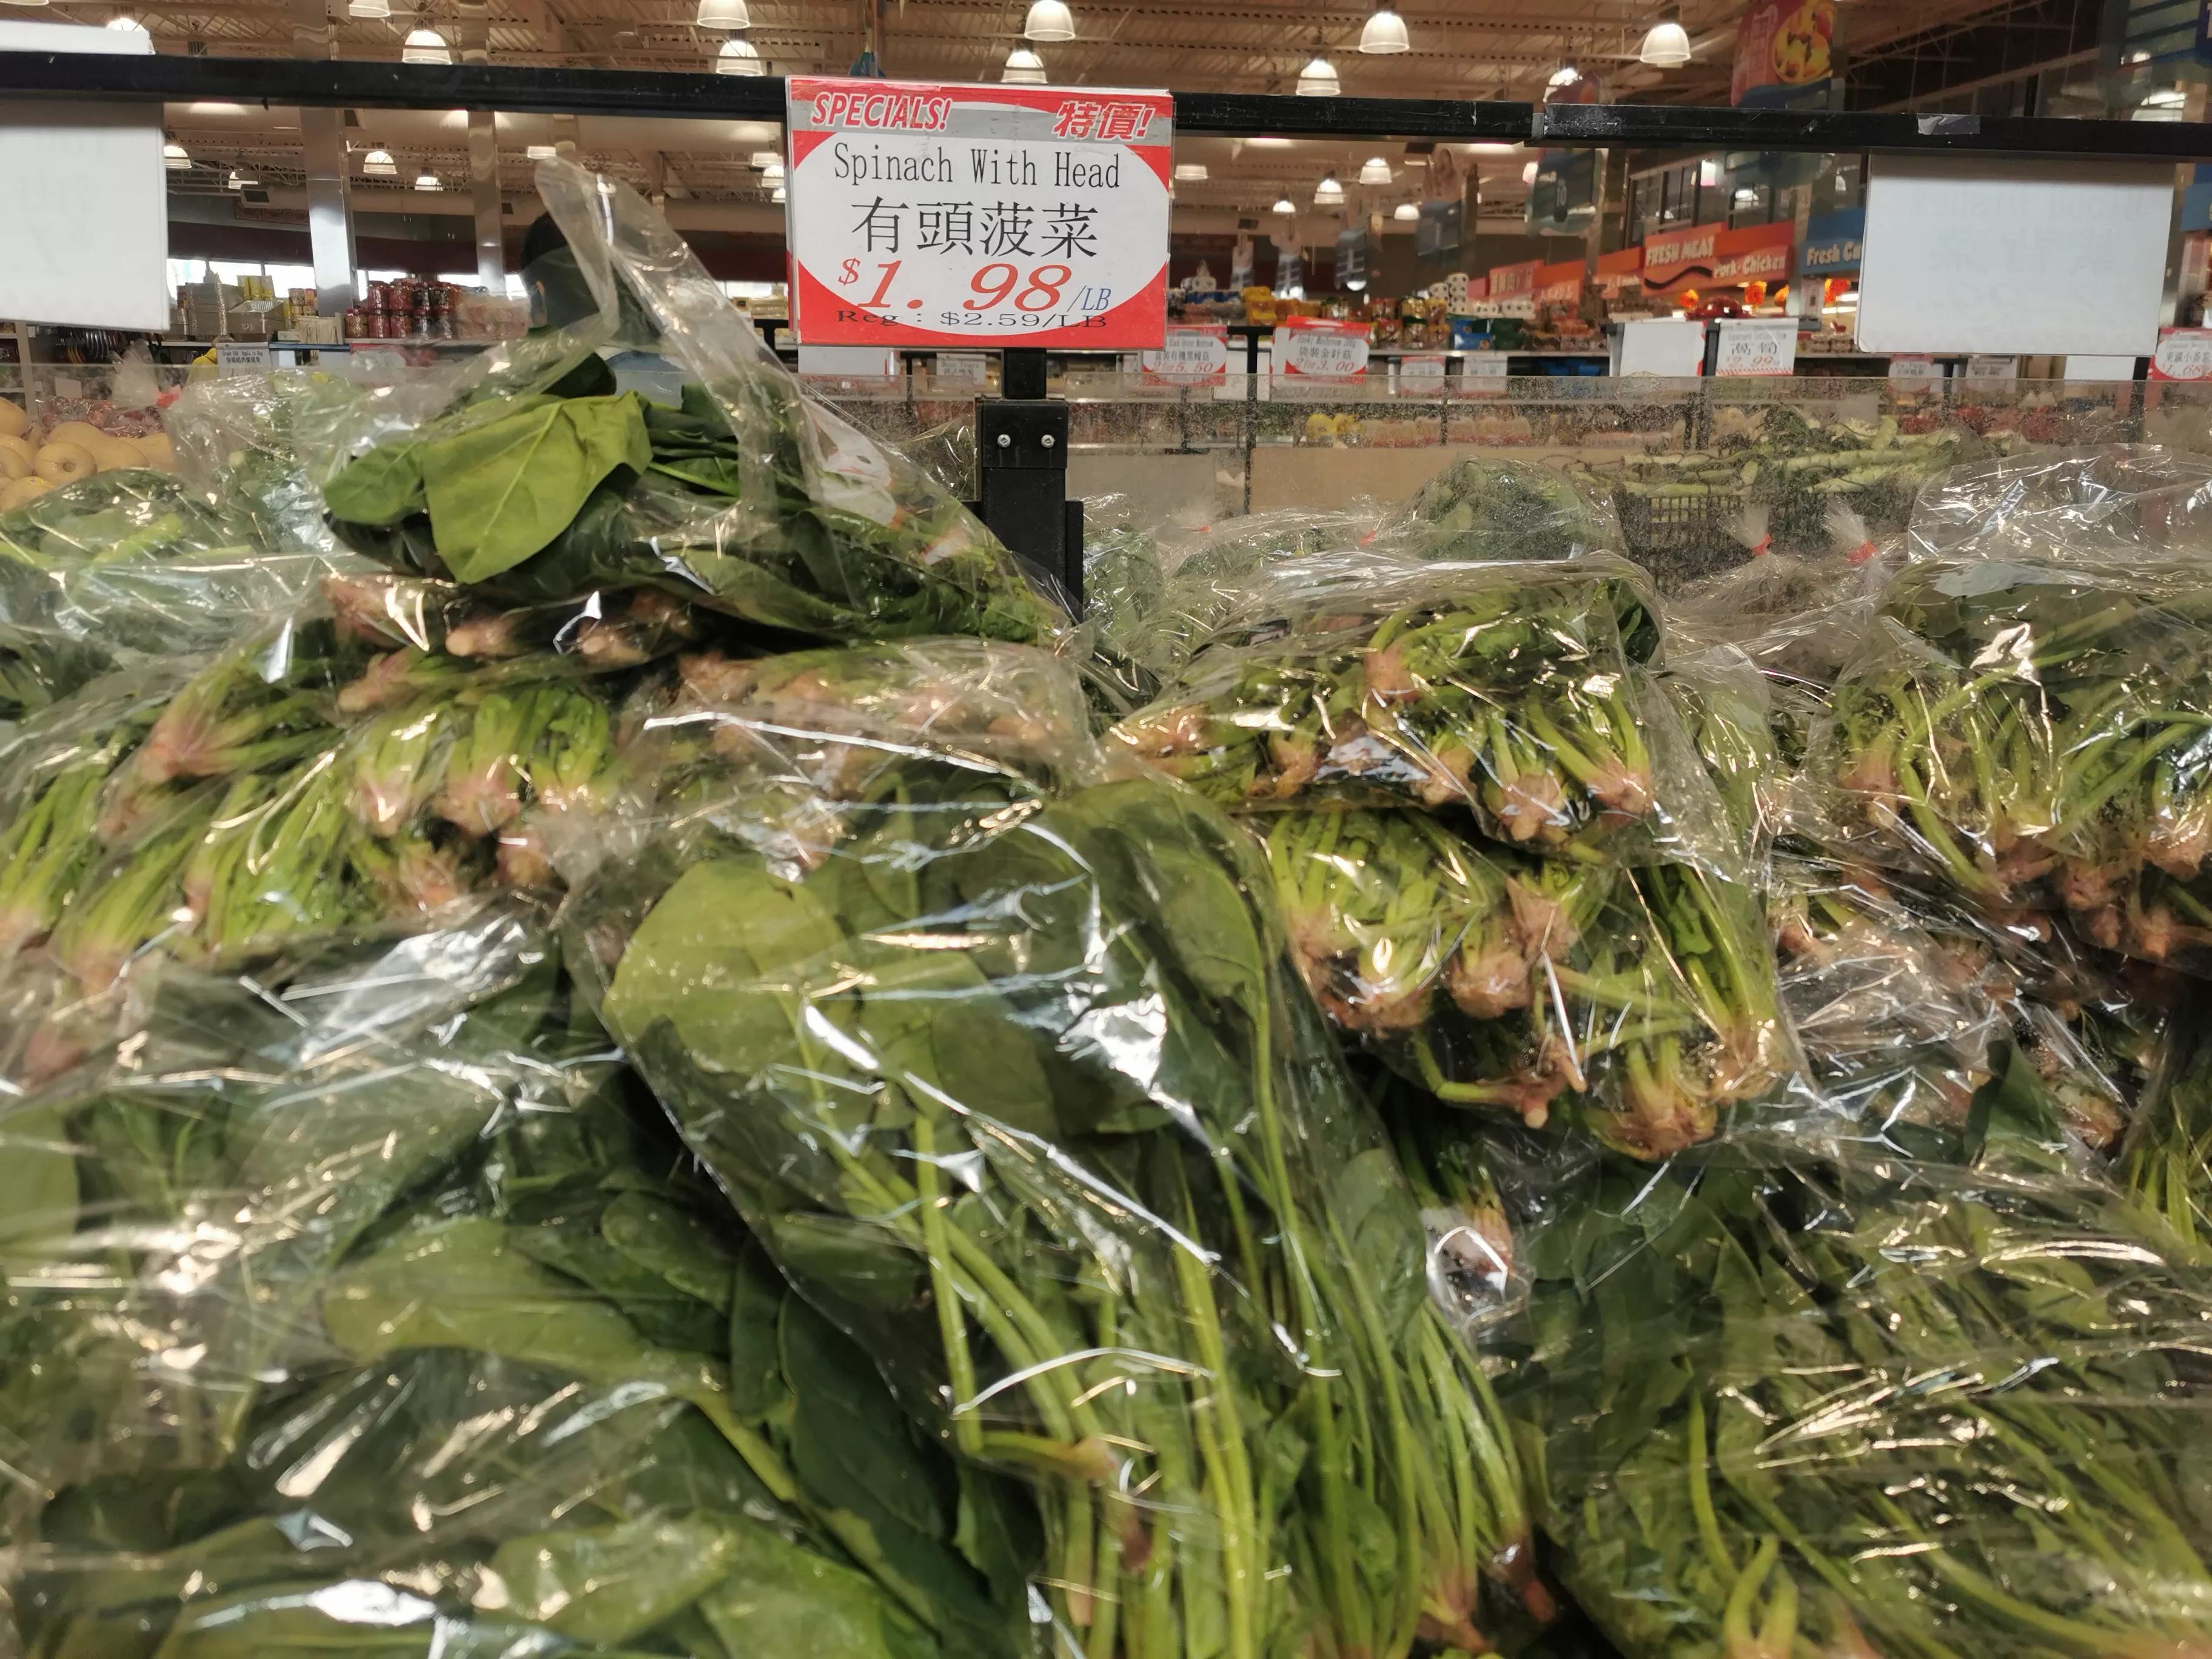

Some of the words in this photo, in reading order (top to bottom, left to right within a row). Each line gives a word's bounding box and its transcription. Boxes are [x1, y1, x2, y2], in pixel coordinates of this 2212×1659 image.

[811, 92, 953, 132] SPECIALS!
[1051, 100, 1155, 141] 特價!
[834, 142, 953, 186] Spinach
[970, 149, 1037, 186] With
[1054, 152, 1120, 189] Head
[851, 196, 1099, 260] 有頭菠菜
[1646, 242, 1680, 266] FRESH
[1680, 235, 1715, 261] MEAT
[1806, 244, 1840, 267] Fresh
[940, 311, 1107, 328] $2.59/LB
